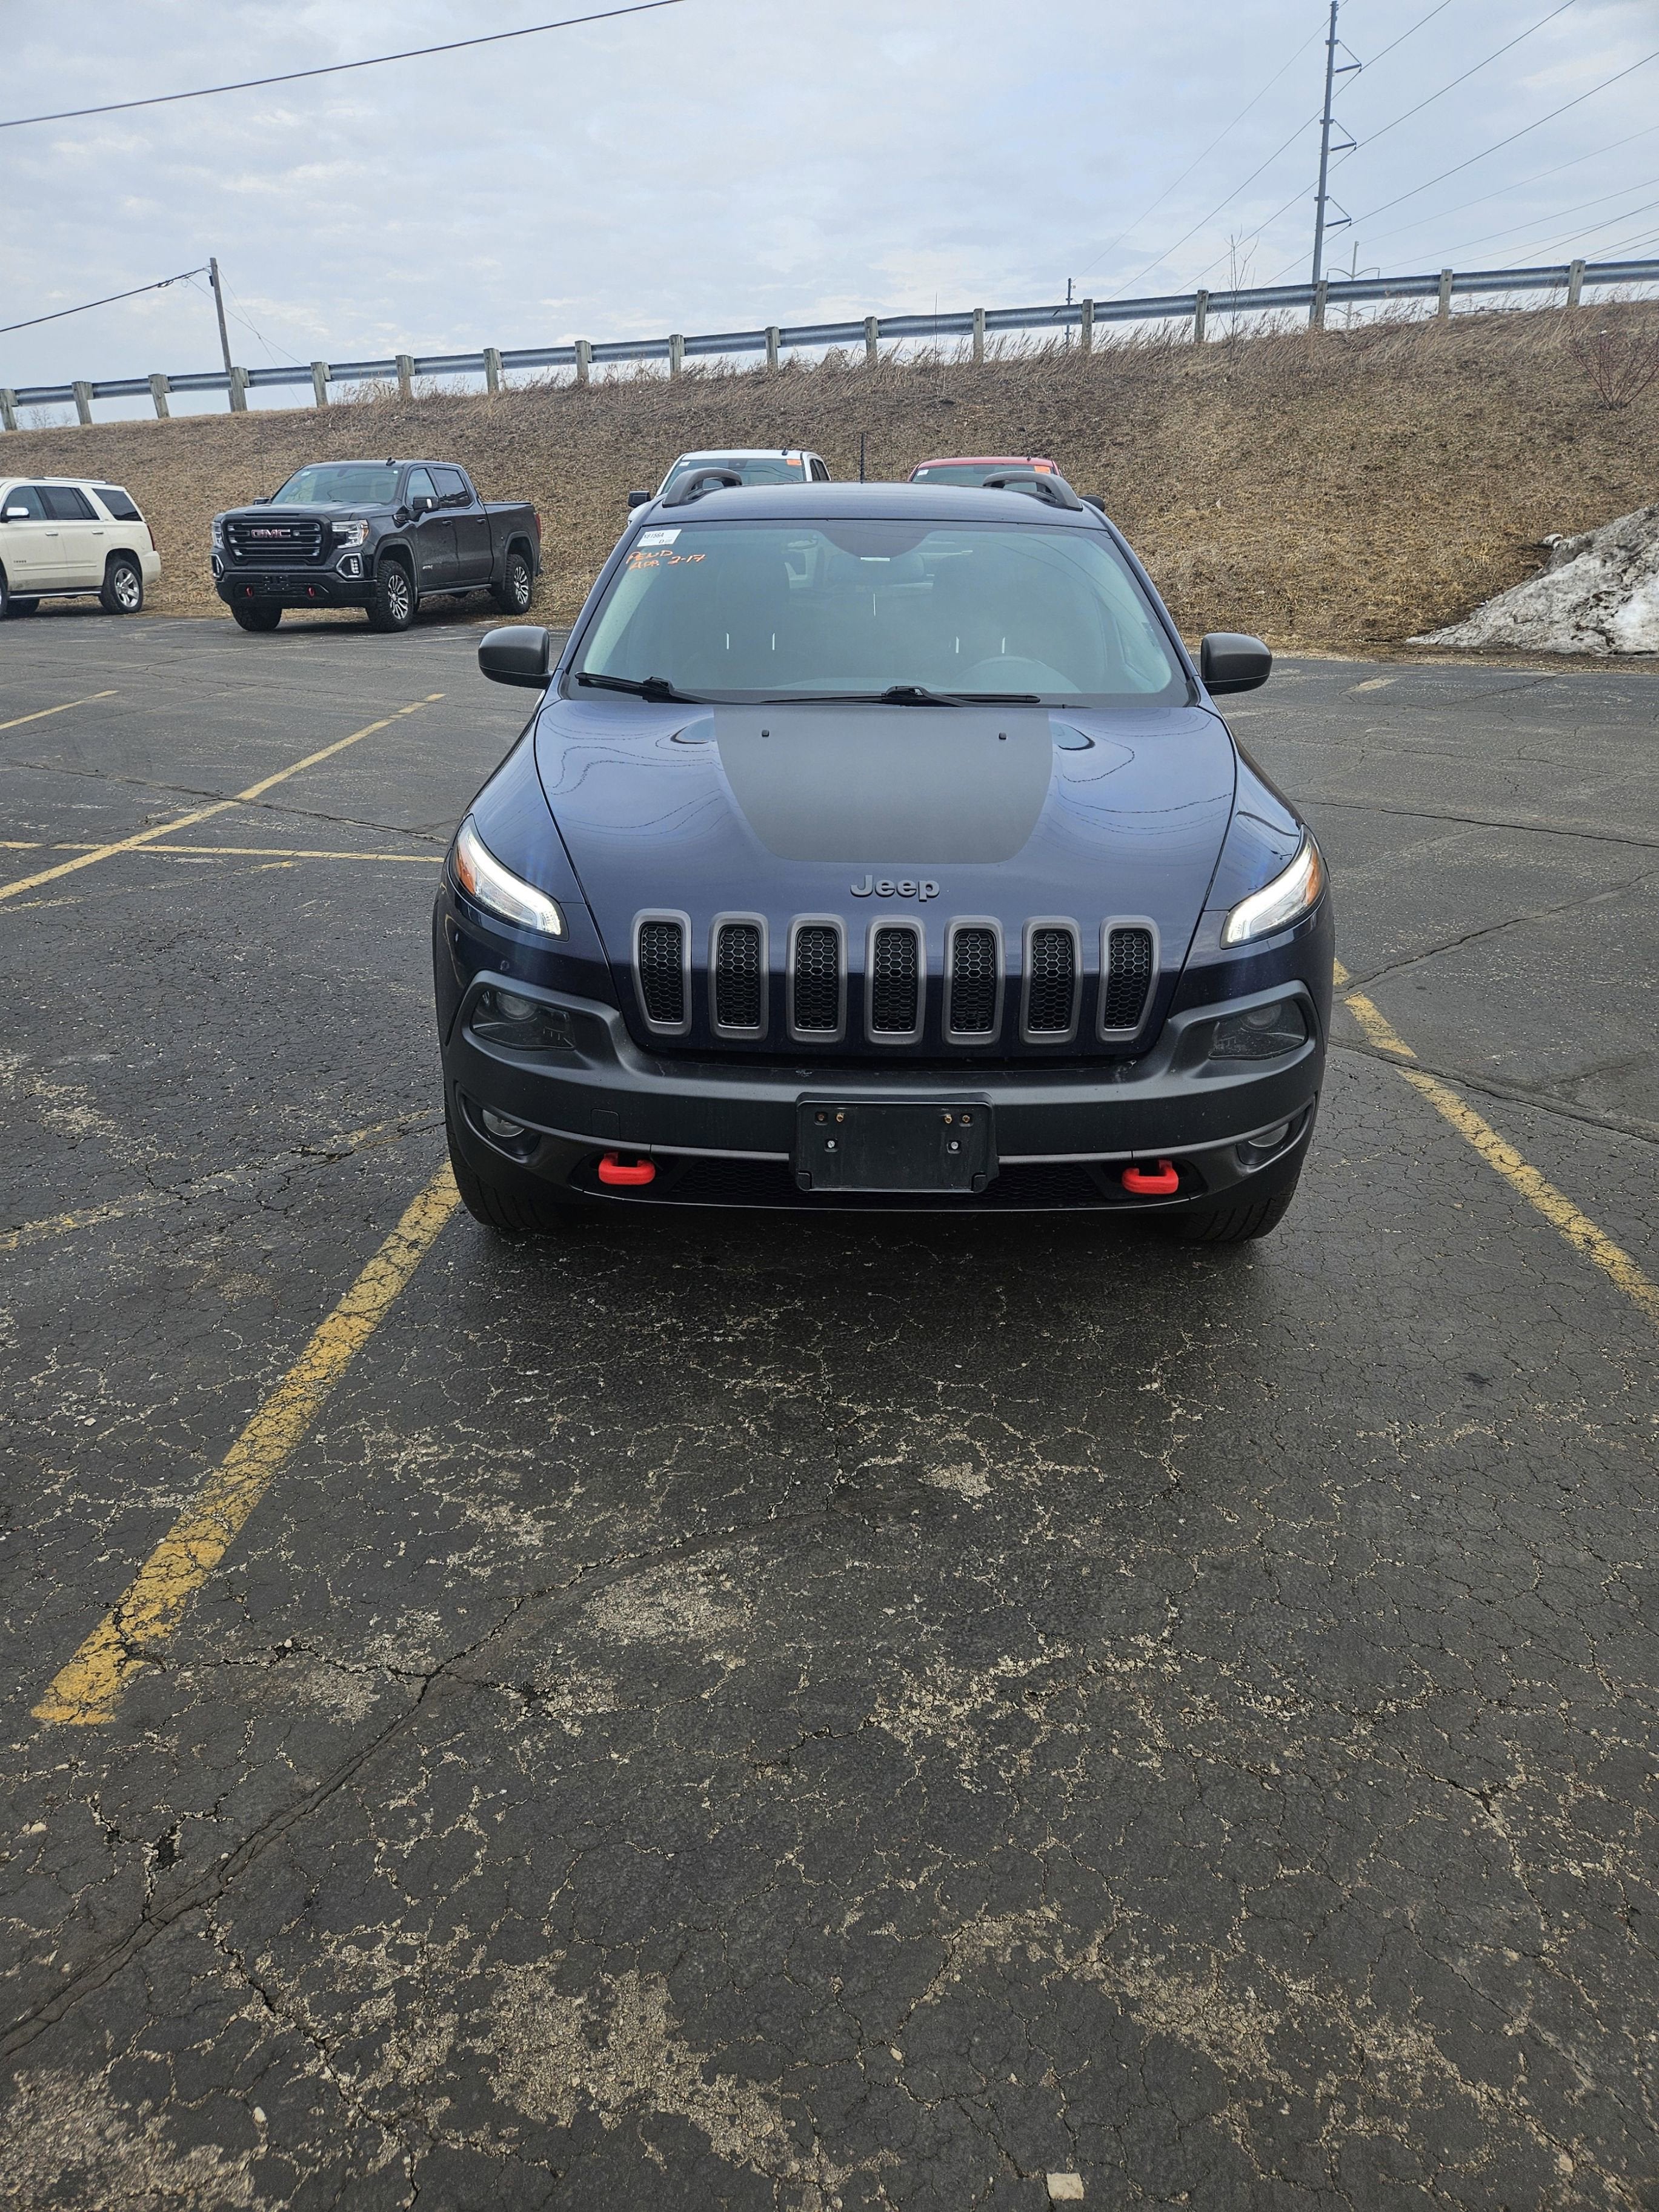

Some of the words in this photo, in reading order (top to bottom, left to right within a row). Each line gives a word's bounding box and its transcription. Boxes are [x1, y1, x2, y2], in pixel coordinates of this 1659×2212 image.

[251, 529, 291, 538] GMC
[668, 554, 706, 565] 2-17
[850, 874, 940, 902] Jeep
